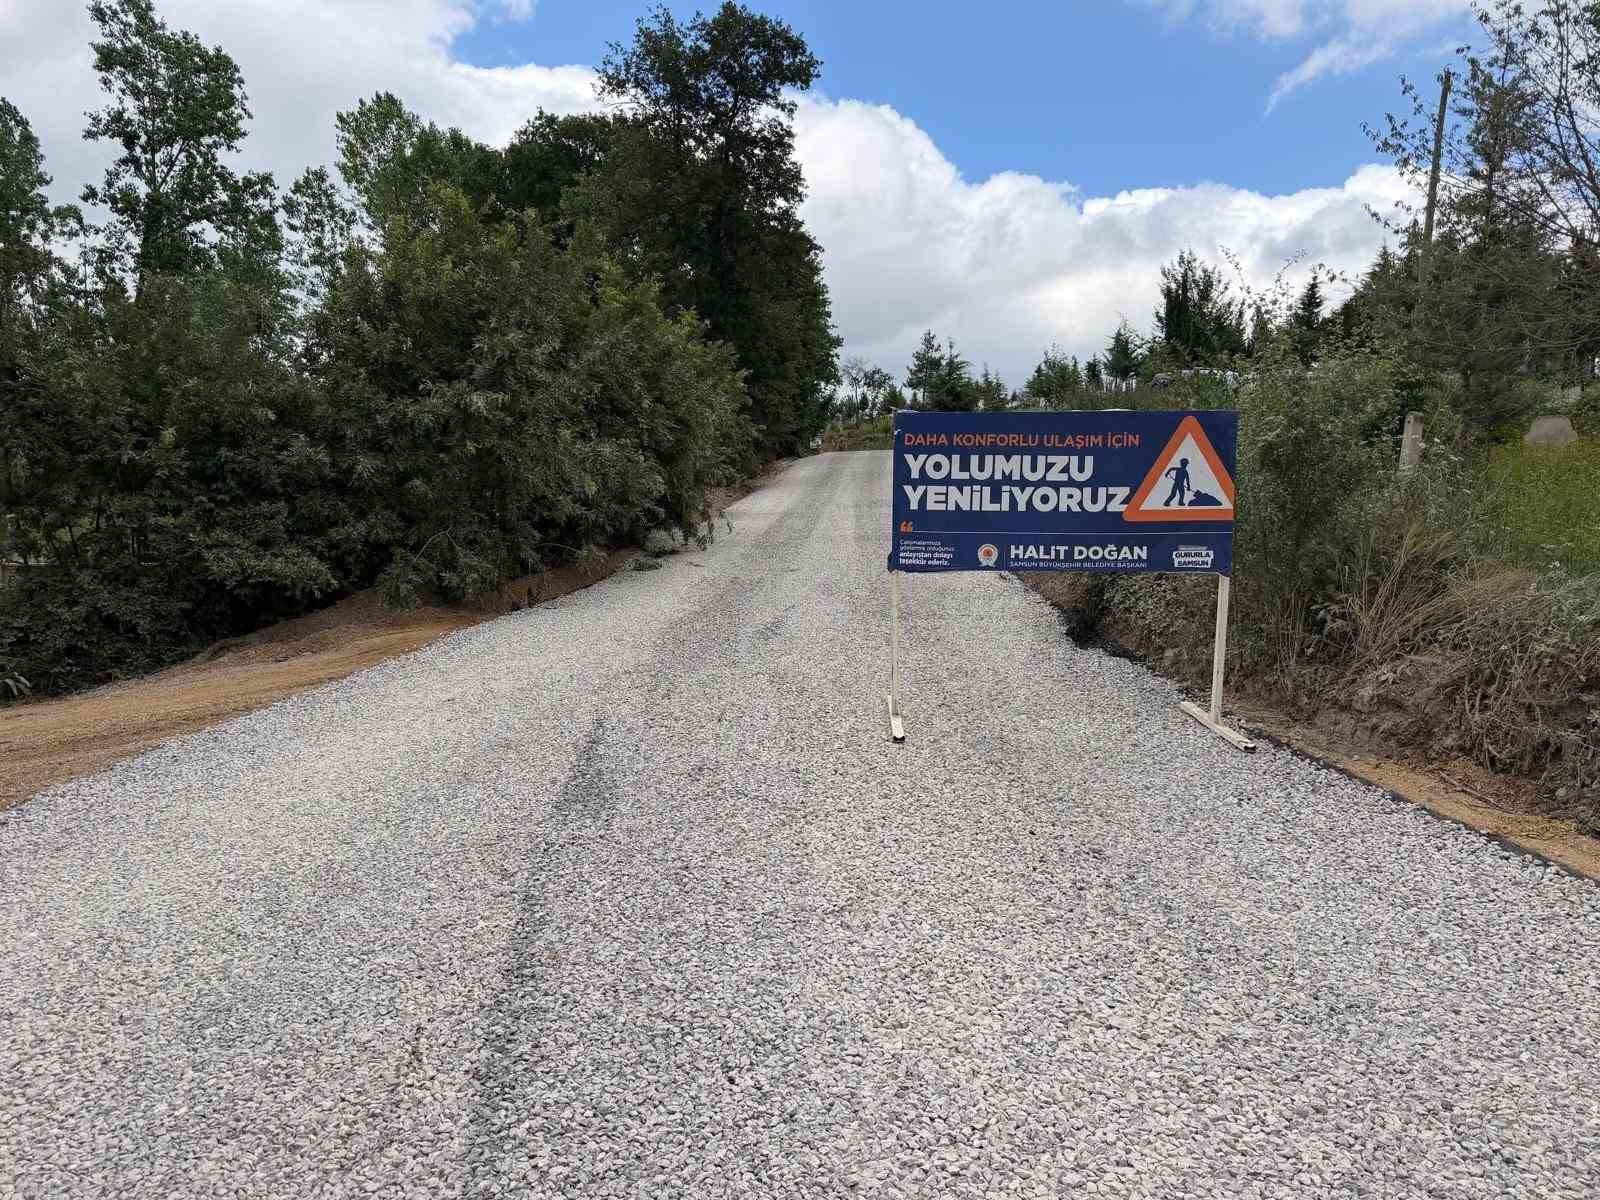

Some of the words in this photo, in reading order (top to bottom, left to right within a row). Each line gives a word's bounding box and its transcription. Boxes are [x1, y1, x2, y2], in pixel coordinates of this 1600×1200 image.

[904, 433, 947, 447] DAHA
[953, 433, 1038, 447] KONFORLU
[1044, 434, 1104, 449] ULAŞIM
[1107, 431, 1140, 449] İÇİN
[904, 454, 1094, 481] YOLUMUZU
[1074, 543, 1147, 561] DOĞAN
[1177, 559, 1209, 567] SAMSUN
